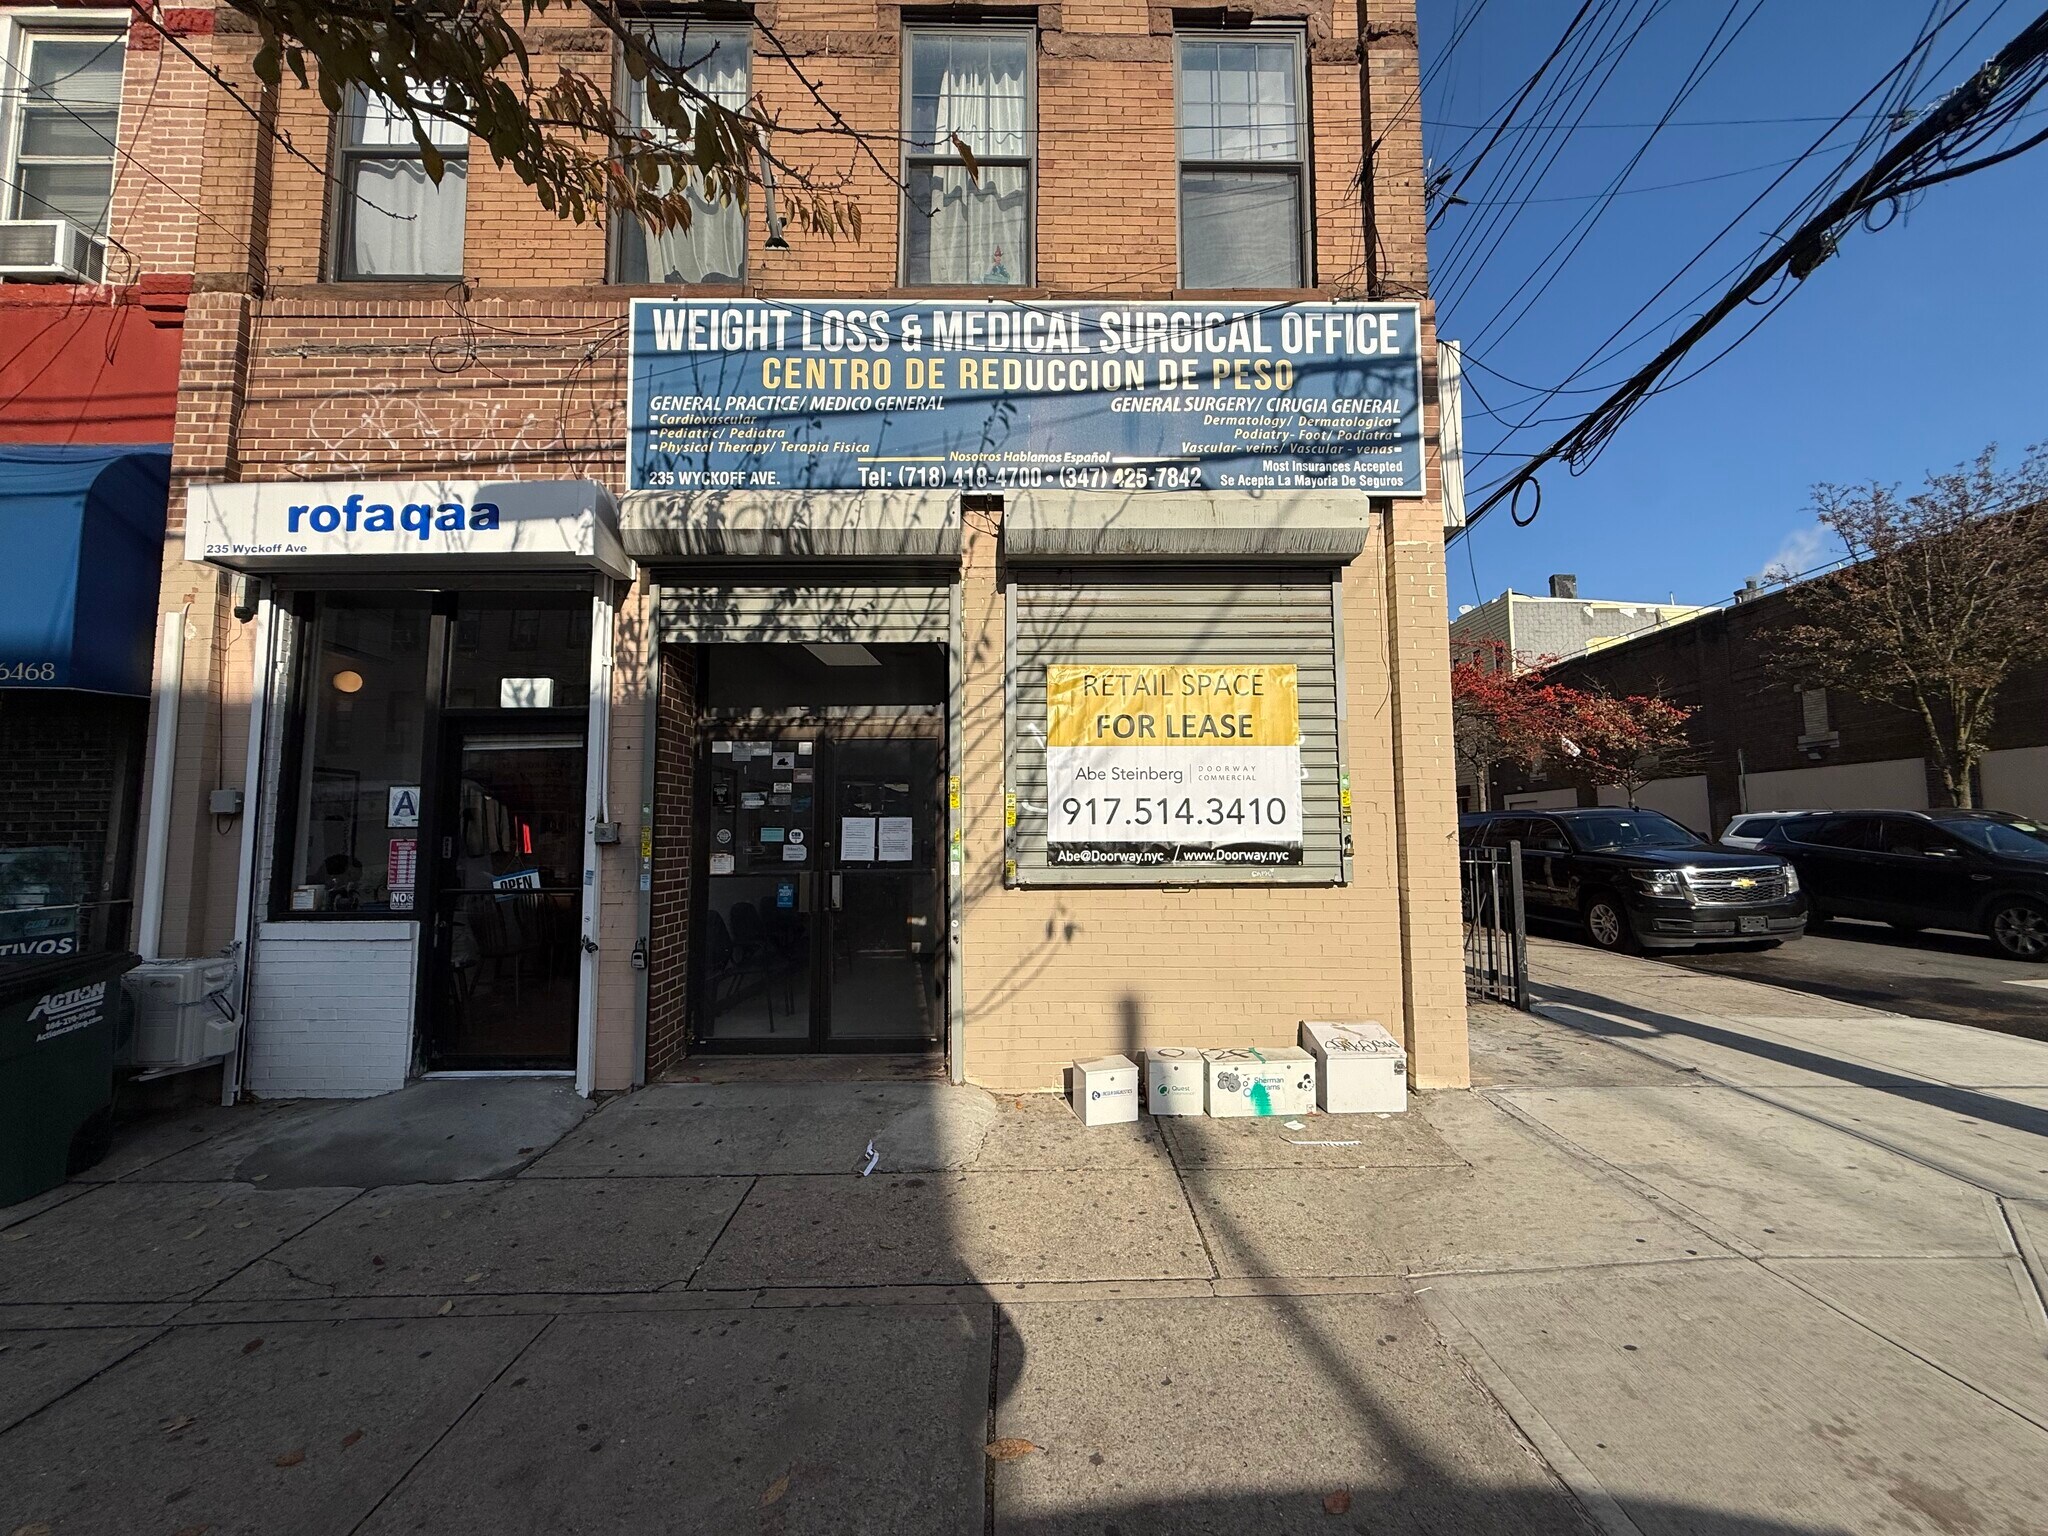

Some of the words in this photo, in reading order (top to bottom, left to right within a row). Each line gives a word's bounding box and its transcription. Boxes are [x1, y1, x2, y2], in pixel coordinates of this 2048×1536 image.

[653, 309, 792, 352] WEIGHT
[802, 309, 889, 352] LOSS
[901, 314, 923, 352] &
[933, 310, 1090, 354] MEDICAL
[1101, 311, 1272, 355] SURGICAL
[1281, 312, 1400, 355] OFFICE
[763, 357, 891, 390] CENTRO
[906, 358, 945, 390] DE
[960, 358, 1145, 391] REDUCCION
[1159, 359, 1199, 391] DE
[1213, 359, 1294, 391] PESO
[650, 395, 722, 411] GENERAL
[725, 395, 807, 411] PRACTICE/
[810, 395, 872, 411] MEDICO
[875, 395, 945, 411] GENERAL
[1111, 397, 1181, 413] GENERAL
[1183, 396, 1261, 413] SURGERY/
[1266, 398, 1328, 414] CIRUGIA
[1332, 399, 1401, 414] GENERAL
[659, 413, 757, 425] Cardiovascular
[1204, 415, 1293, 429] Dermatology/
[1298, 416, 1392, 430] Dermatologica
[659, 427, 725, 439] Pediatric/
[729, 427, 786, 439] Pediatra
[1234, 428, 1295, 442] Podiatry-
[1299, 430, 1333, 441] Foot/
[1337, 430, 1392, 441] Podiatra
[659, 441, 713, 454] Physical
[718, 441, 776, 454] Therapy/
[781, 441, 829, 454] Terapia
[833, 442, 870, 453] Fisica
[1182, 442, 1242, 453] Vascular-
[1246, 443, 1286, 454] veins/
[1290, 443, 1344, 454] Vascular
[1357, 445, 1393, 454] venas
[949, 452, 1001, 462] Nosotros
[1003, 452, 1062, 463] Hablamos
[1064, 452, 1111, 465] Español
[1262, 460, 1289, 472] Most
[1292, 460, 1350, 472] Insurances
[1353, 461, 1403, 474] Accepted
[649, 471, 674, 485] 235
[679, 471, 746, 485] WYCKOFF
[750, 471, 781, 485] AVE.
[858, 466, 892, 487] Tel:
[898, 465, 947, 488] (718)
[953, 466, 1042, 488] 418-4700
[1060, 465, 1107, 488] (347)
[1113, 466, 1202, 488] 425-7842
[1220, 475, 1235, 487] Se
[1238, 475, 1274, 489] Acepta
[1278, 475, 1291, 487] La
[1295, 475, 1337, 489] Mayoria
[1342, 475, 1356, 487] De
[1359, 476, 1404, 489] Seguros
[287, 494, 500, 540] rofaqaa
[206, 544, 229, 554] 235
[232, 543, 282, 554] Wyckoff
[285, 544, 308, 554] Ave
[1084, 674, 1173, 696] RETAIL
[1182, 673, 1264, 696] SPACE
[1096, 714, 1155, 739] FOR
[1166, 714, 1254, 739] LEASE
[1075, 766, 1106, 781] Abe
[1111, 766, 1183, 784] Steinberg
[392, 791, 416, 816] A
[1062, 797, 1287, 826] 917.514.3410
[1057, 850, 1164, 865] Abe@Doorway.nyc
[1183, 849, 1290, 864] www.Doorway.nyc
